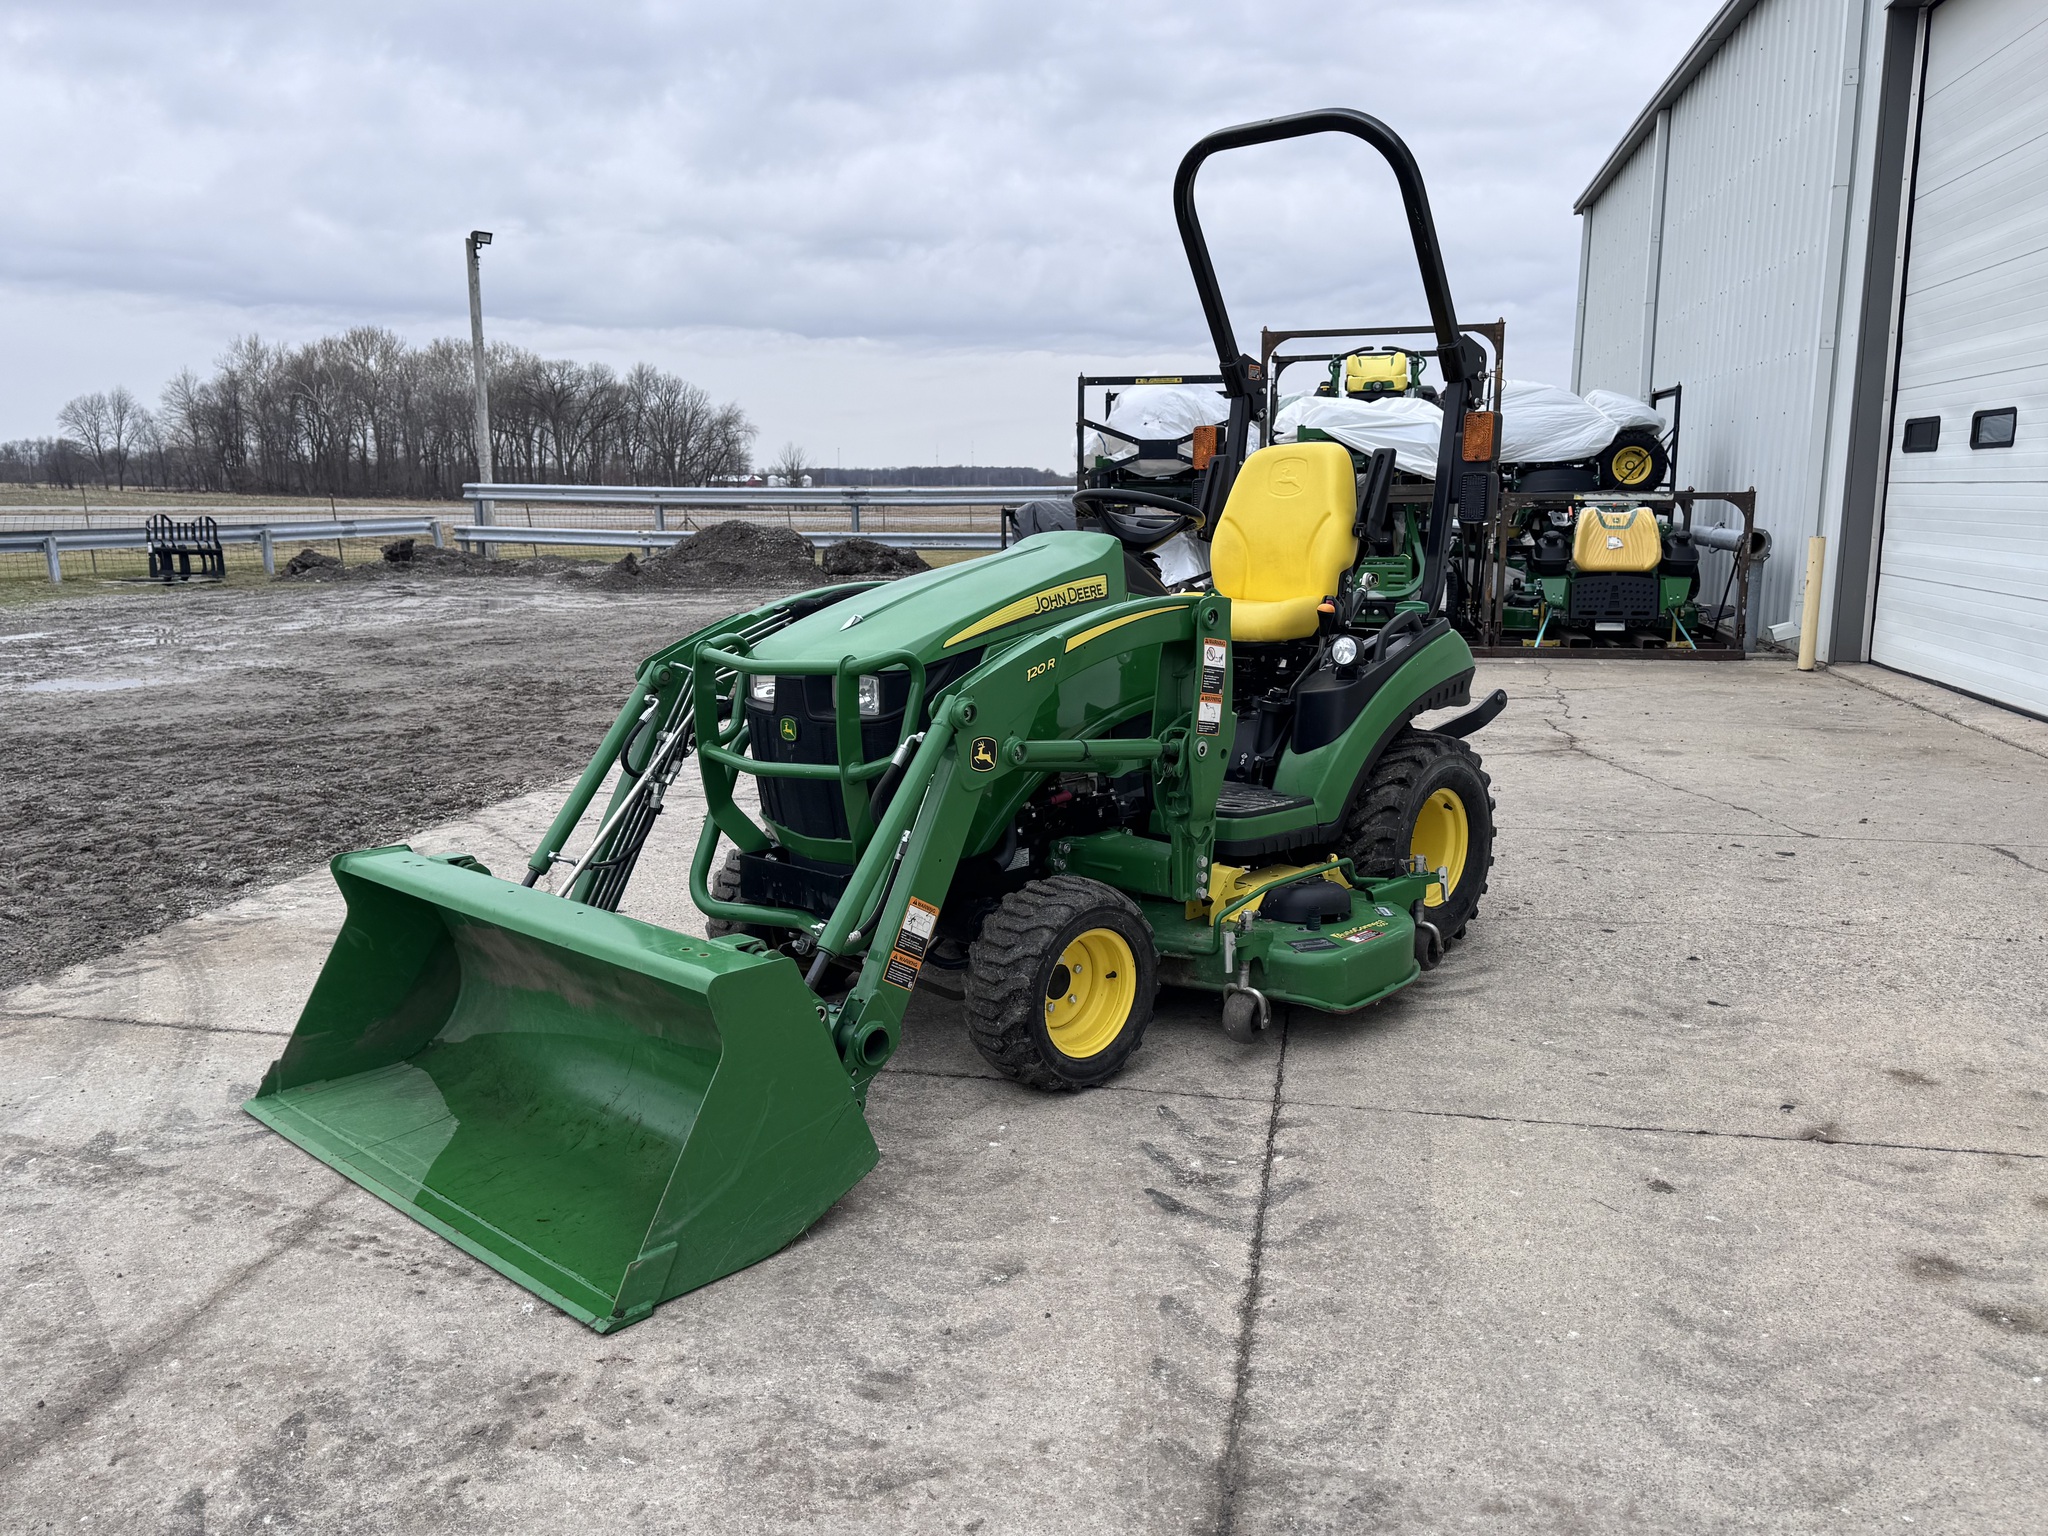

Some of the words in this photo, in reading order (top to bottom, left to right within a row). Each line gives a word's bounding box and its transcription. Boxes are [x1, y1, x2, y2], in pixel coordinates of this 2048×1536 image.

[1034, 592, 1067, 613] JOHN
[1067, 583, 1104, 603] DEERE
[1026, 662, 1046, 682] 120
[1047, 657, 1056, 670] R
[917, 902, 936, 914] WARNING
[899, 956, 918, 968] WARNING
